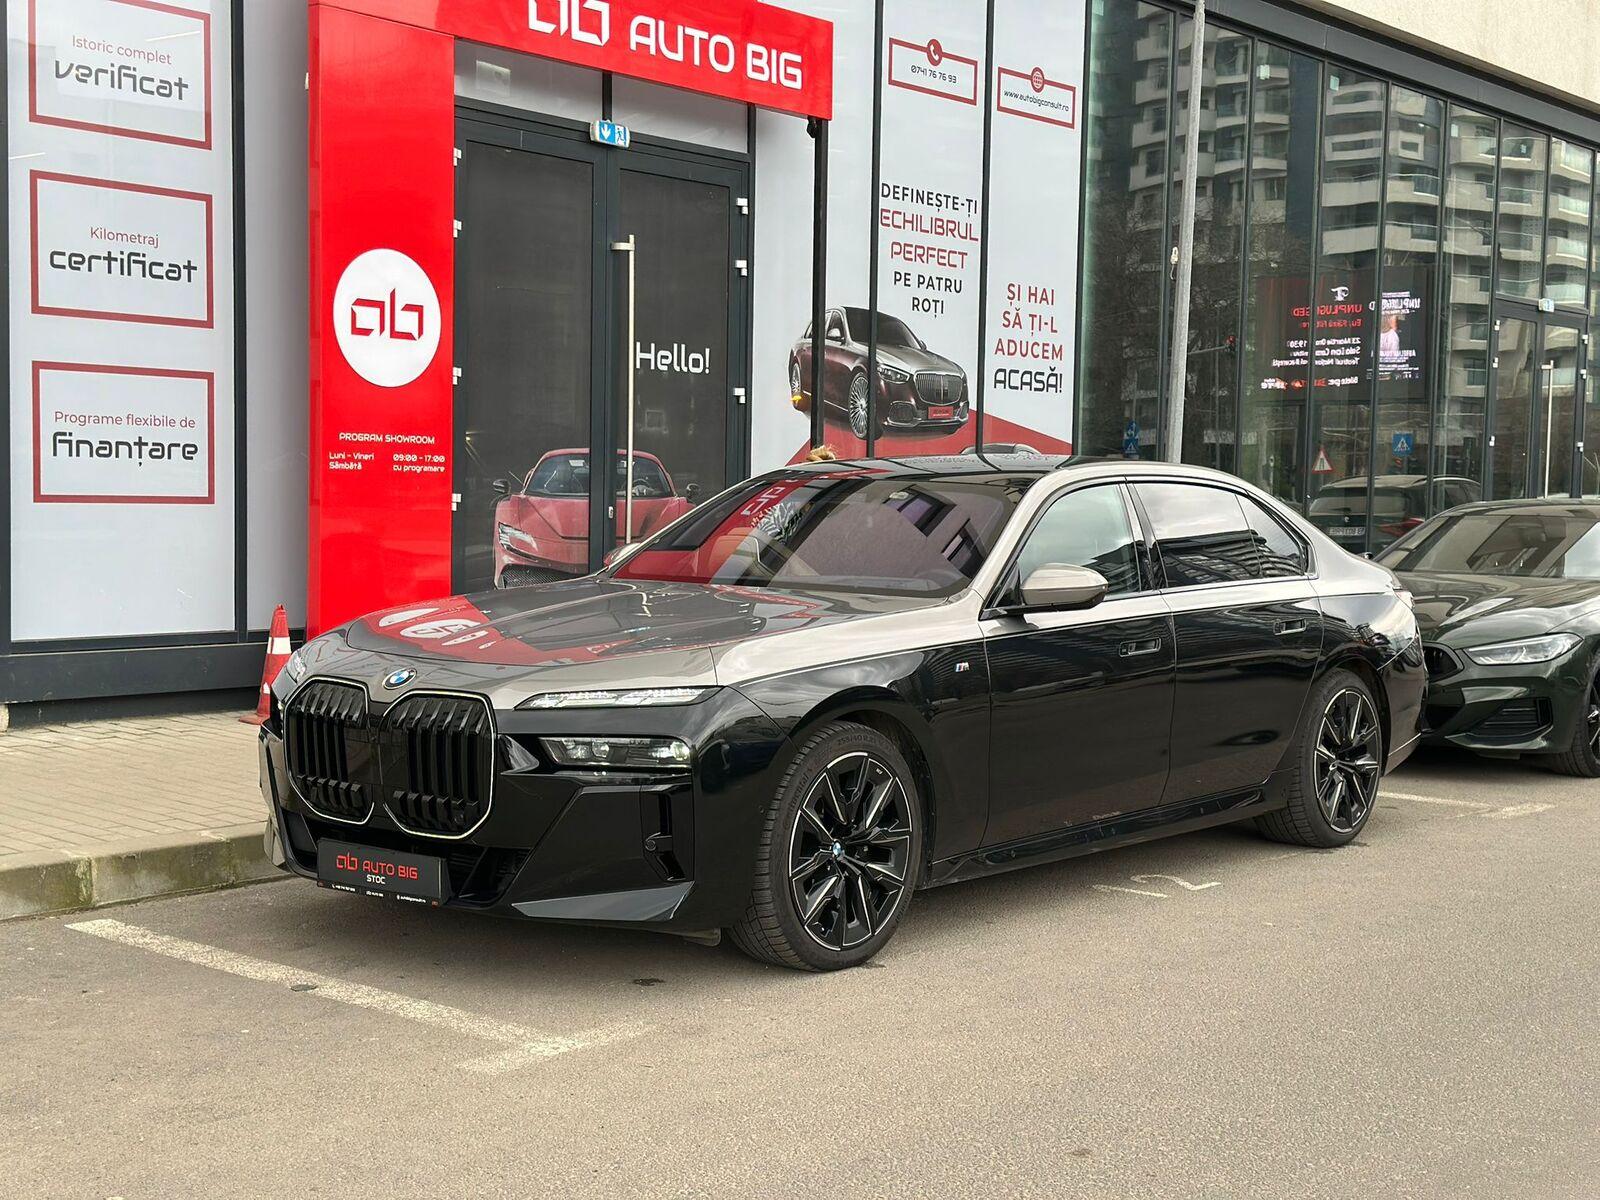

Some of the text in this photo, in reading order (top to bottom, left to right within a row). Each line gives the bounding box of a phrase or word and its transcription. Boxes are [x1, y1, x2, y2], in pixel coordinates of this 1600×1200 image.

[72, 36, 172, 65] Istoric complet
[629, 16, 734, 73] AUTO
[745, 43, 802, 90] BIG
[54, 60, 189, 100] verificat
[911, 64, 957, 84] 0741 76 76 93
[881, 182, 978, 217] DEFINEȘTE-ȚI
[880, 208, 979, 242] ECHILIBRUL
[90, 226, 158, 248] Kilometraj
[49, 248, 198, 283] certificat
[890, 242, 968, 268] PERFECT
[894, 271, 962, 294] PE PATRU
[1007, 283, 1055, 306] ȘI HAI
[912, 296, 944, 318] ROȚI
[1002, 308, 1058, 336] SĂ ȚI-L
[636, 342, 710, 374] Hello!
[994, 338, 1063, 361] ADUCEM
[994, 366, 1062, 394] ACASĂ!
[54, 411, 196, 430] Programe flexibile de
[52, 431, 198, 467] finanțare
[339, 432, 434, 444] PROGRAM SHOWROOM
[329, 452, 345, 460] Luni
[353, 452, 374, 460] Vineri
[393, 454, 417, 462] 09:00
[424, 454, 445, 462] 17:00
[404, 466, 445, 474] programare
[362, 860, 395, 876] AUTO
[398, 865, 418, 880] BIG
[366, 874, 386, 884] STOC
